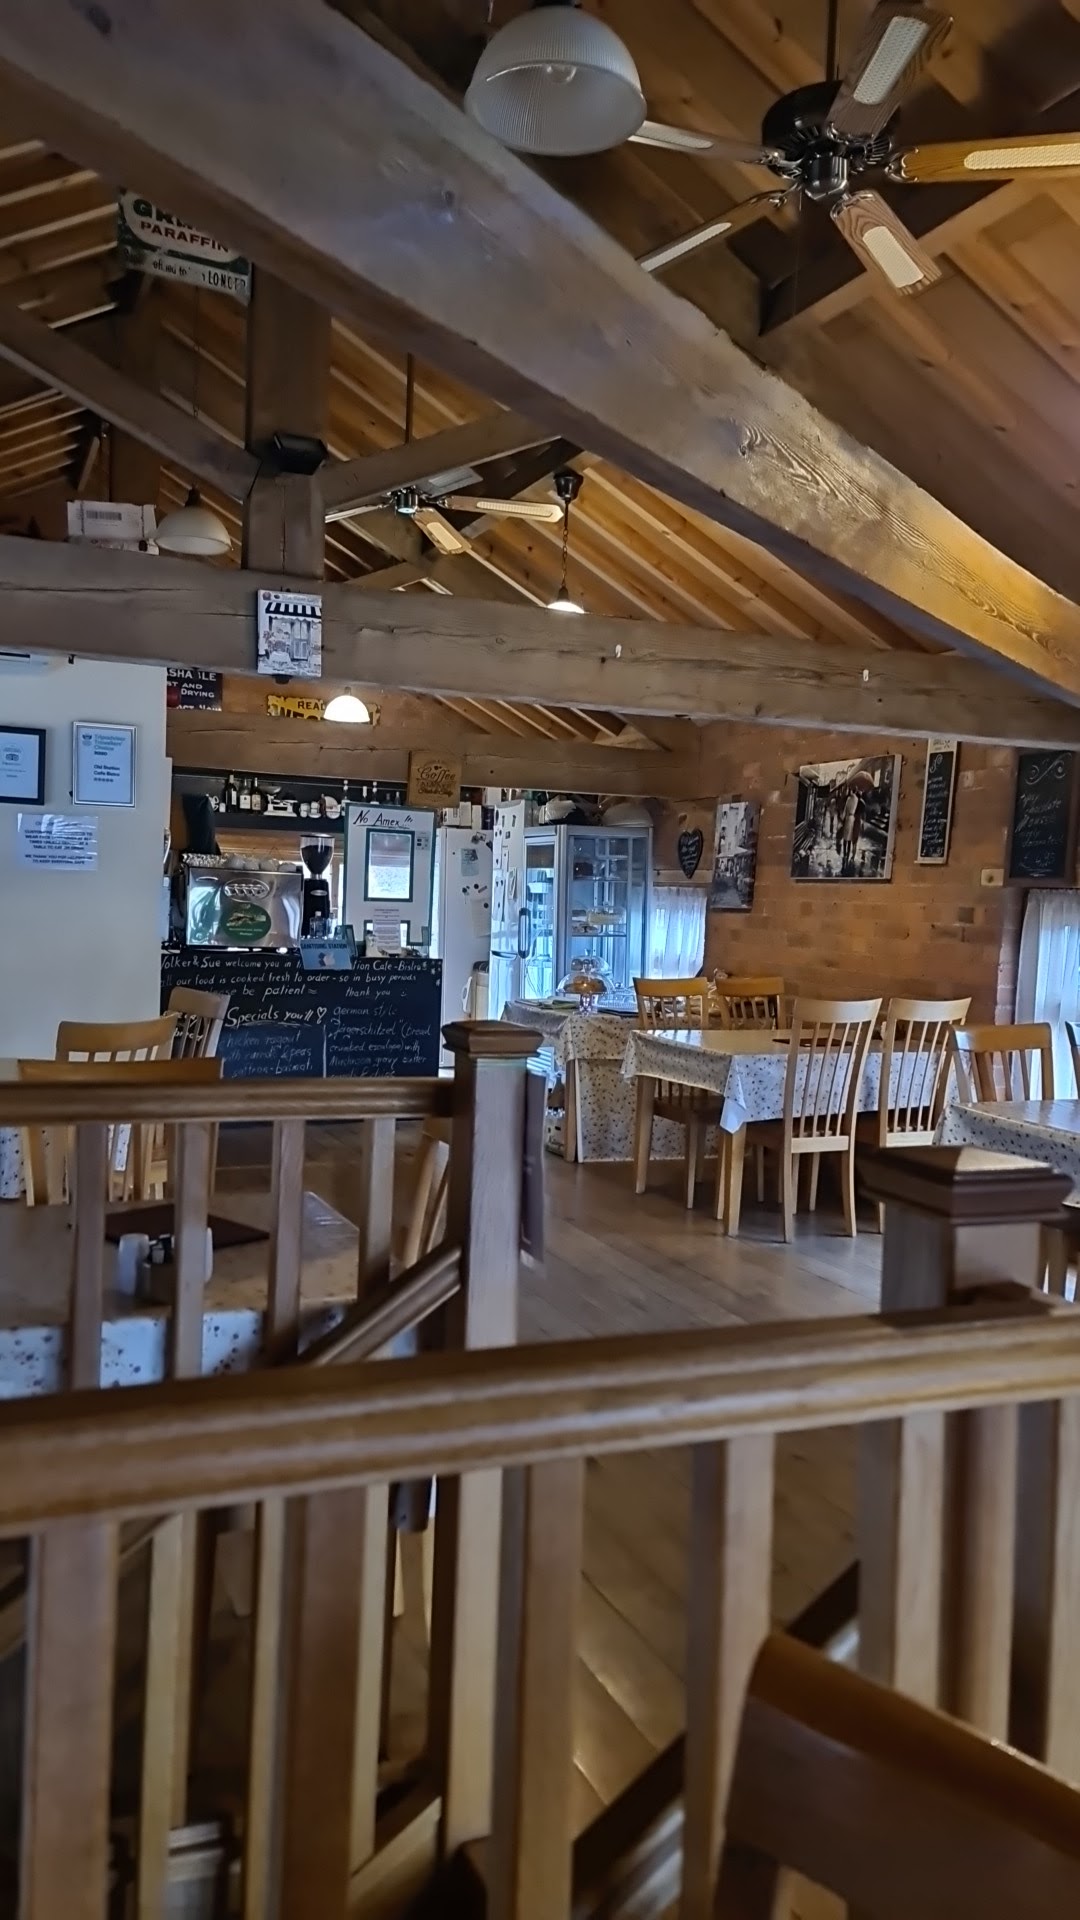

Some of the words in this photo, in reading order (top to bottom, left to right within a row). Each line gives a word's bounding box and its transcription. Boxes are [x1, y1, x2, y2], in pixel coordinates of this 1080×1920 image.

[182, 682, 203, 690] AND
[181, 688, 215, 699] DRYING
[416, 766, 456, 784] Coffee
[353, 810, 371, 825] No
[374, 813, 400, 827] Amex
[225, 957, 262, 968] welcome
[265, 960, 280, 970] you
[284, 960, 292, 968] in
[195, 974, 215, 985] food
[219, 976, 226, 984] is
[230, 972, 265, 984] cooked
[268, 971, 290, 983] fresh
[294, 971, 303, 983] to
[307, 974, 330, 982] order
[352, 973, 361, 982] in
[366, 971, 386, 985] busy
[389, 974, 416, 984] periods
[243, 983, 255, 996] be
[262, 982, 306, 1002] patient
[345, 986, 370, 998] thank
[376, 990, 391, 1000] you
[224, 1005, 279, 1029] Specials
